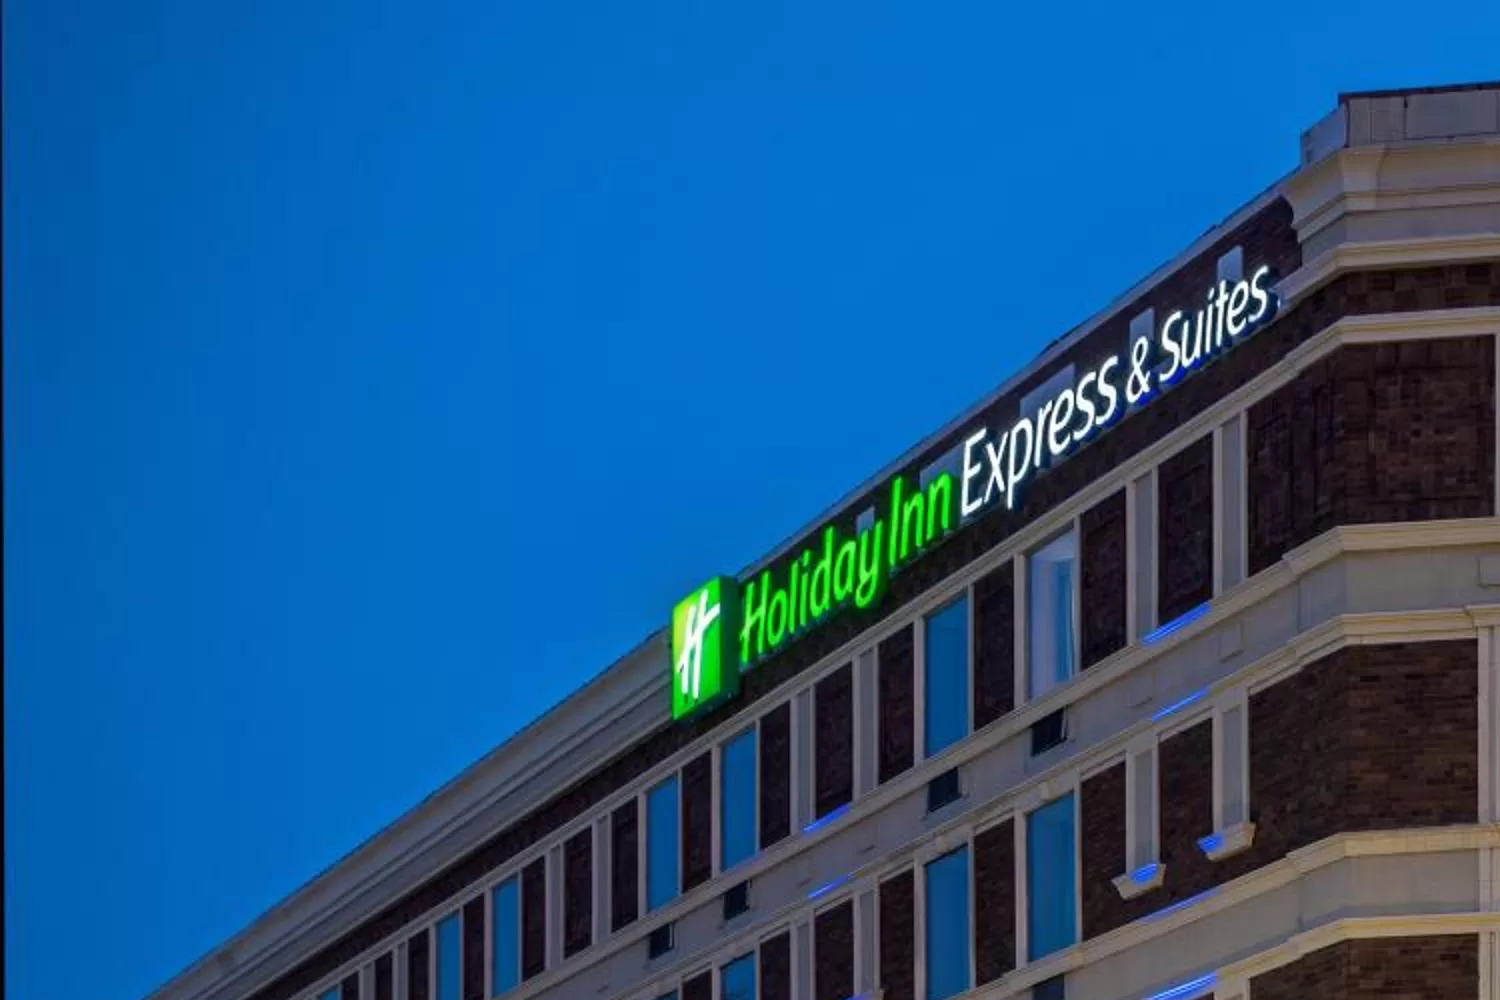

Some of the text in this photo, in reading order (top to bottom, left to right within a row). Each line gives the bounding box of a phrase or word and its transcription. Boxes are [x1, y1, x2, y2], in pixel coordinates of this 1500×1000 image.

[739, 525, 884, 665] Holiday
[888, 475, 953, 567] Inn
[960, 354, 1119, 517] Express
[1125, 335, 1152, 404] &
[1158, 264, 1270, 382] Suites
